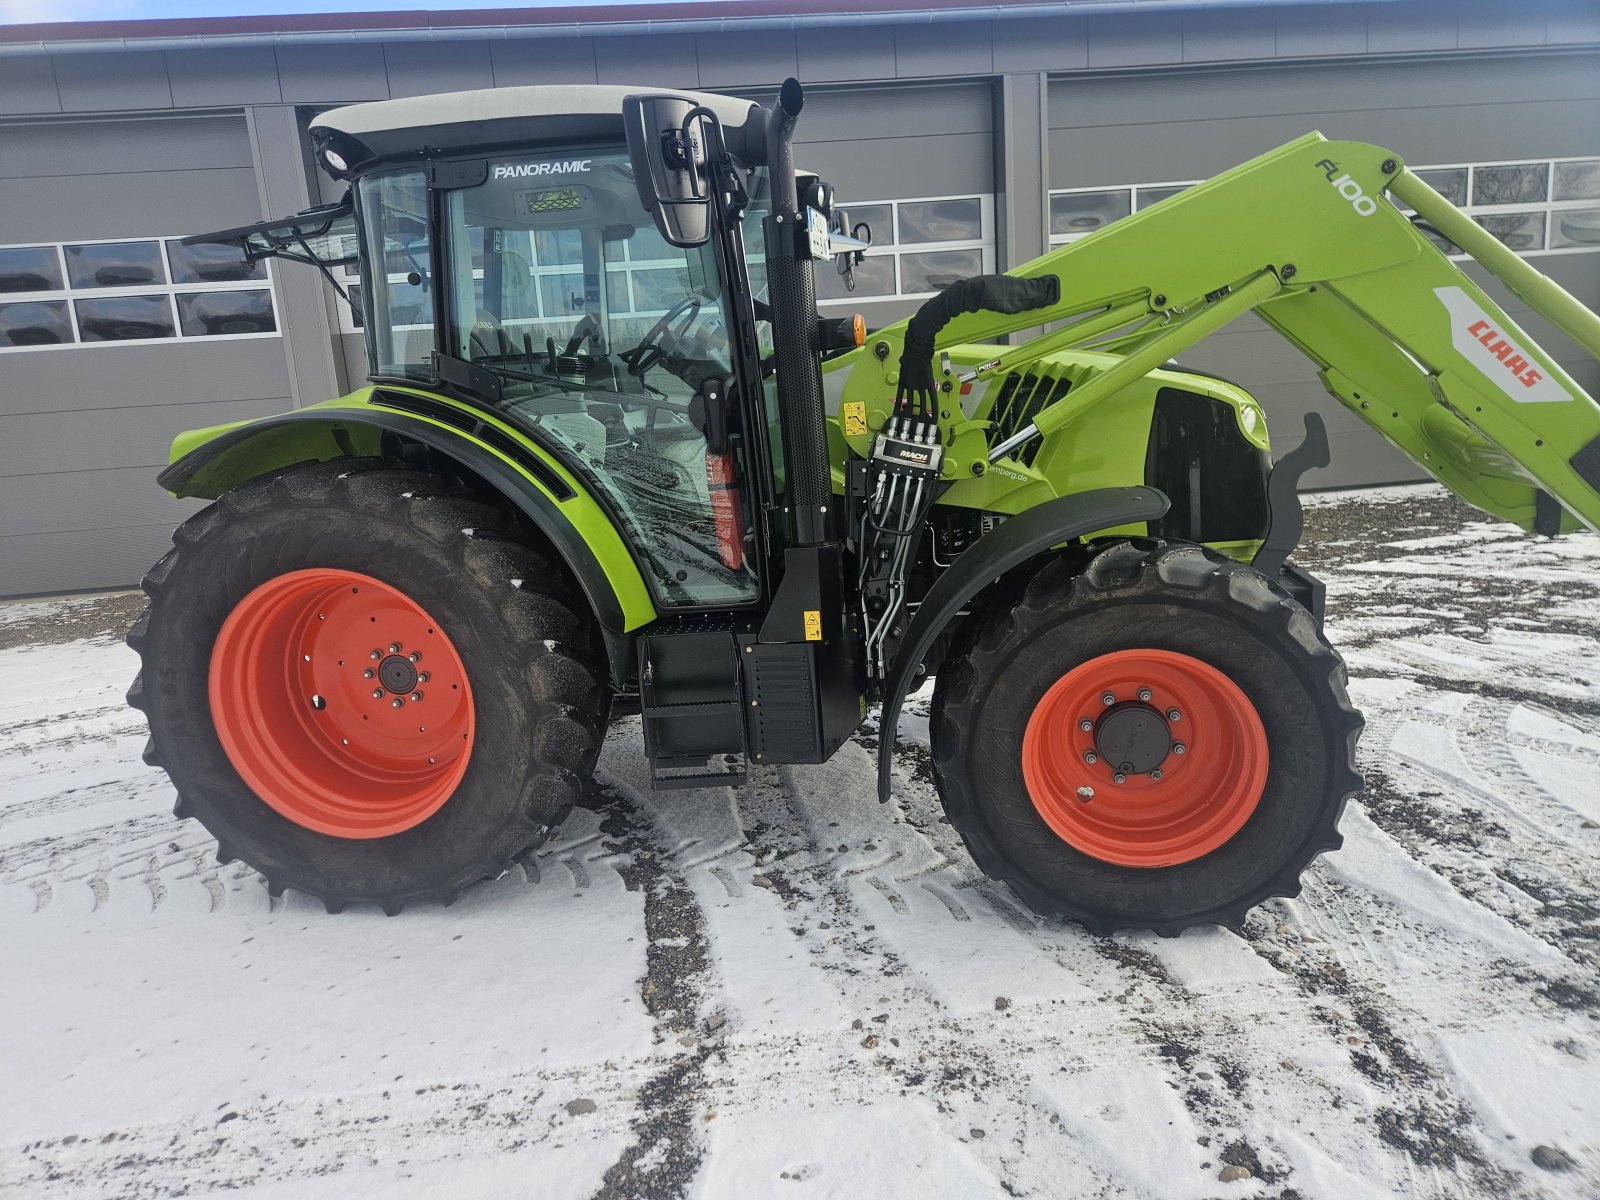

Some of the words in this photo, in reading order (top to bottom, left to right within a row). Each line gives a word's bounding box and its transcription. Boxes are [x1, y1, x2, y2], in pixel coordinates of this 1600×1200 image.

[494, 160, 591, 179] PANORAMIC
[1467, 319, 1543, 388] CLAAS
[900, 450, 928, 461] MACH
